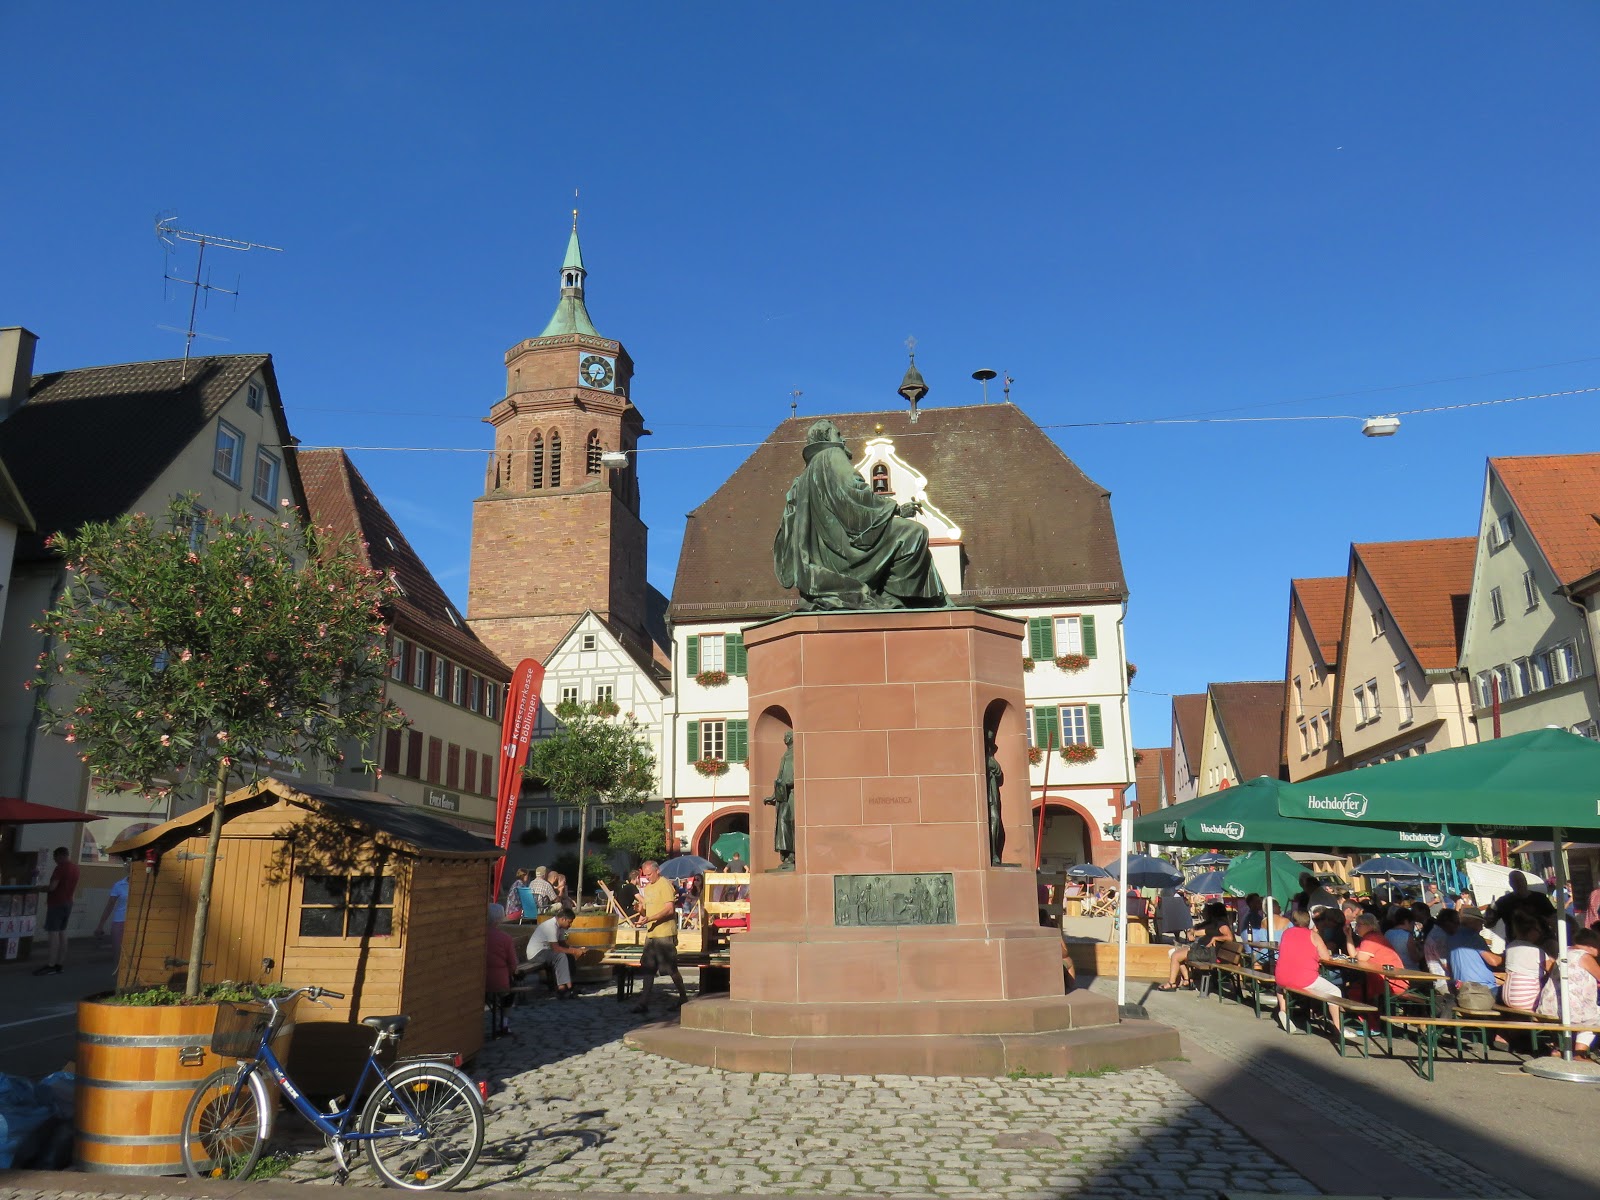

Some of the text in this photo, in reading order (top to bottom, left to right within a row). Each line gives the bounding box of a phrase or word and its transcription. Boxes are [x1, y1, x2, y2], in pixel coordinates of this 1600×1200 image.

[512, 667, 534, 740] Kreissparkasse
[519, 694, 537, 743] Böblingen
[1308, 795, 1360, 810] Hochdorfer
[1200, 823, 1239, 835] Hochdorfer
